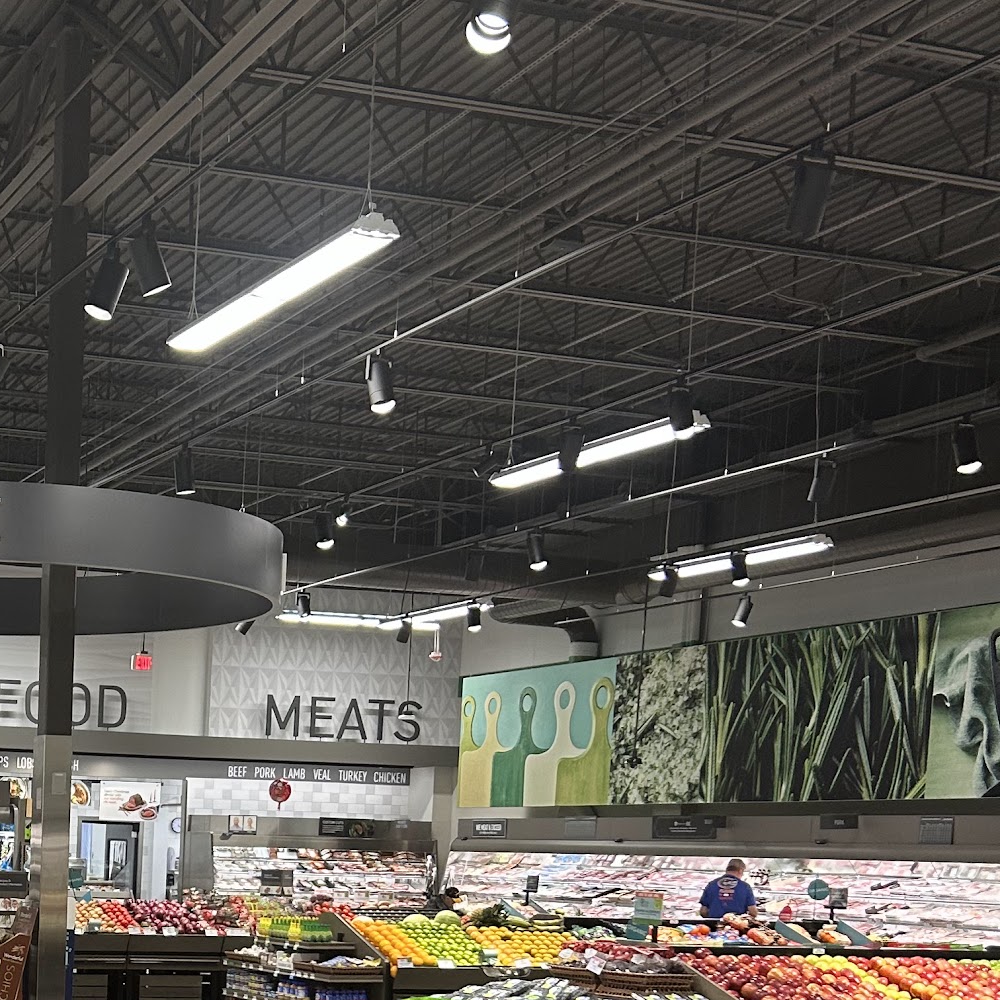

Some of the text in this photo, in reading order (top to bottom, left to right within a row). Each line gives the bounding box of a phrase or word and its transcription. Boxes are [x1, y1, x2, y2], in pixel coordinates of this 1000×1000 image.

[265, 694, 423, 742] MEATS
[227, 766, 406, 784] BEEF PORK LAMB VEAL TURKEY CHICKEN
